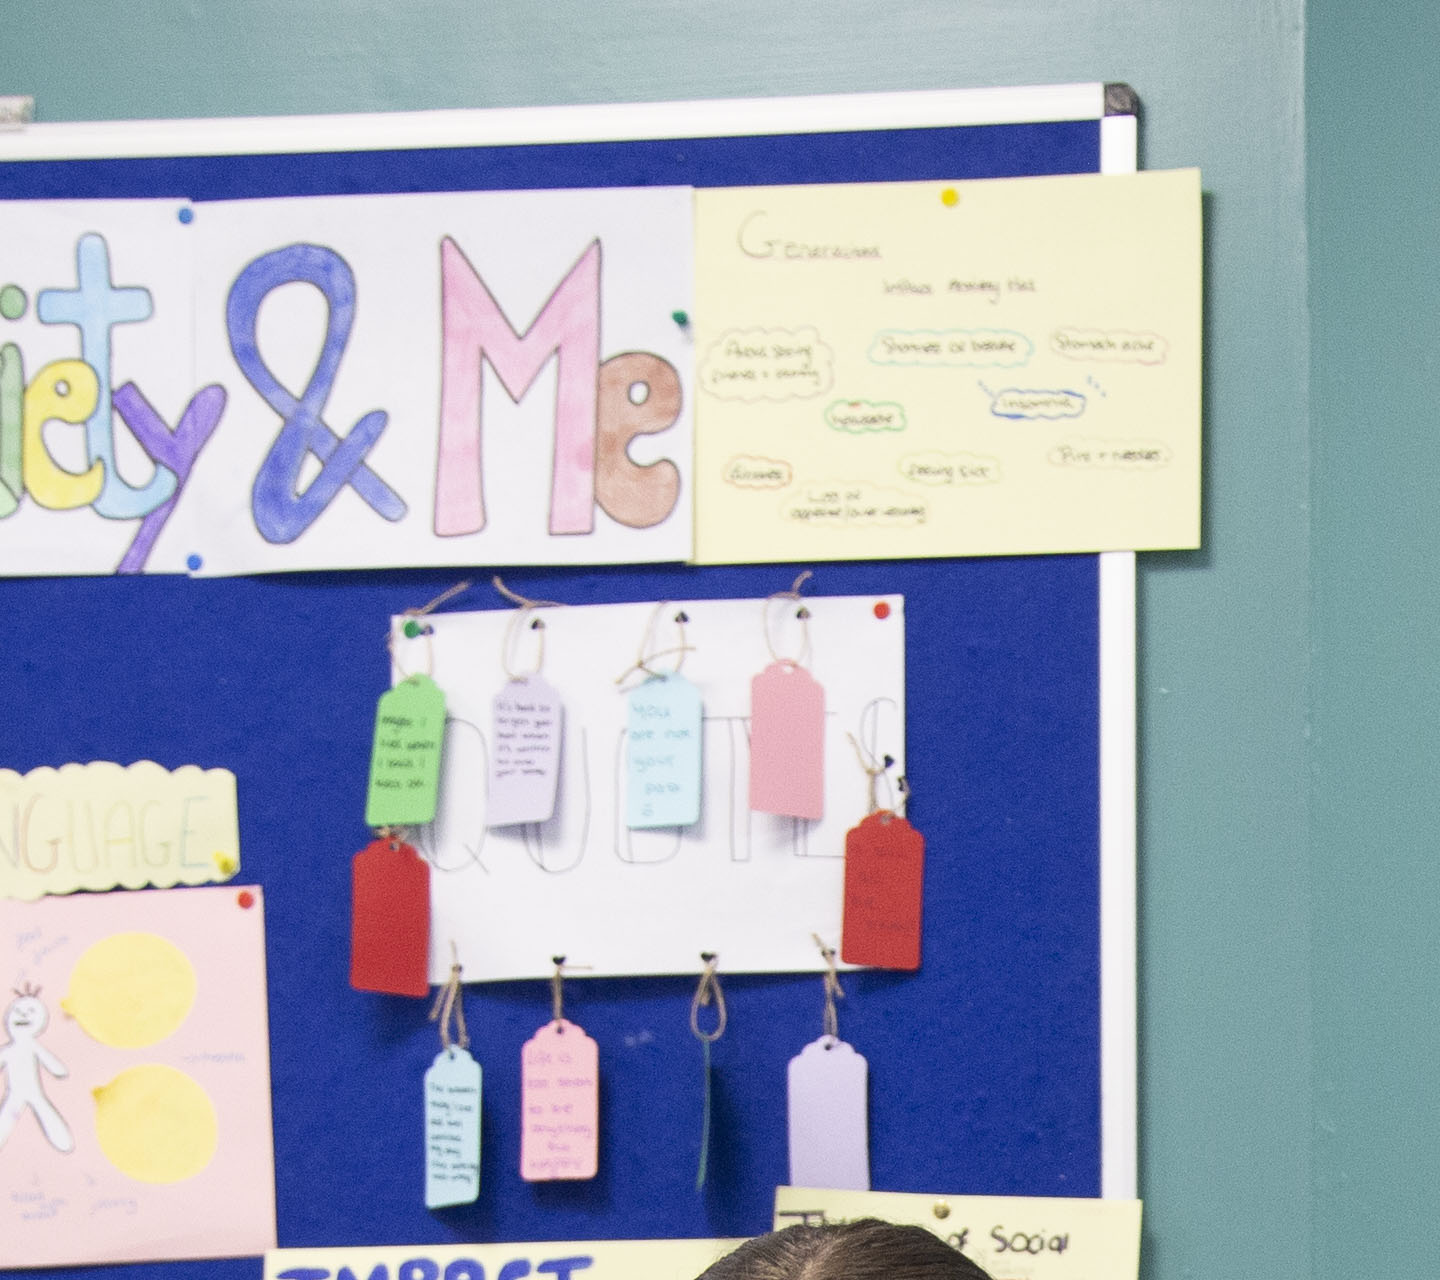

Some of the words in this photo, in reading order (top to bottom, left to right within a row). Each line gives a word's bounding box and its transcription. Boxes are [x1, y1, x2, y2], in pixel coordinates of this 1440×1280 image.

[226, 242, 408, 544] &
[435, 234, 683, 537] Me
[988, 1223, 1071, 1256] Social
